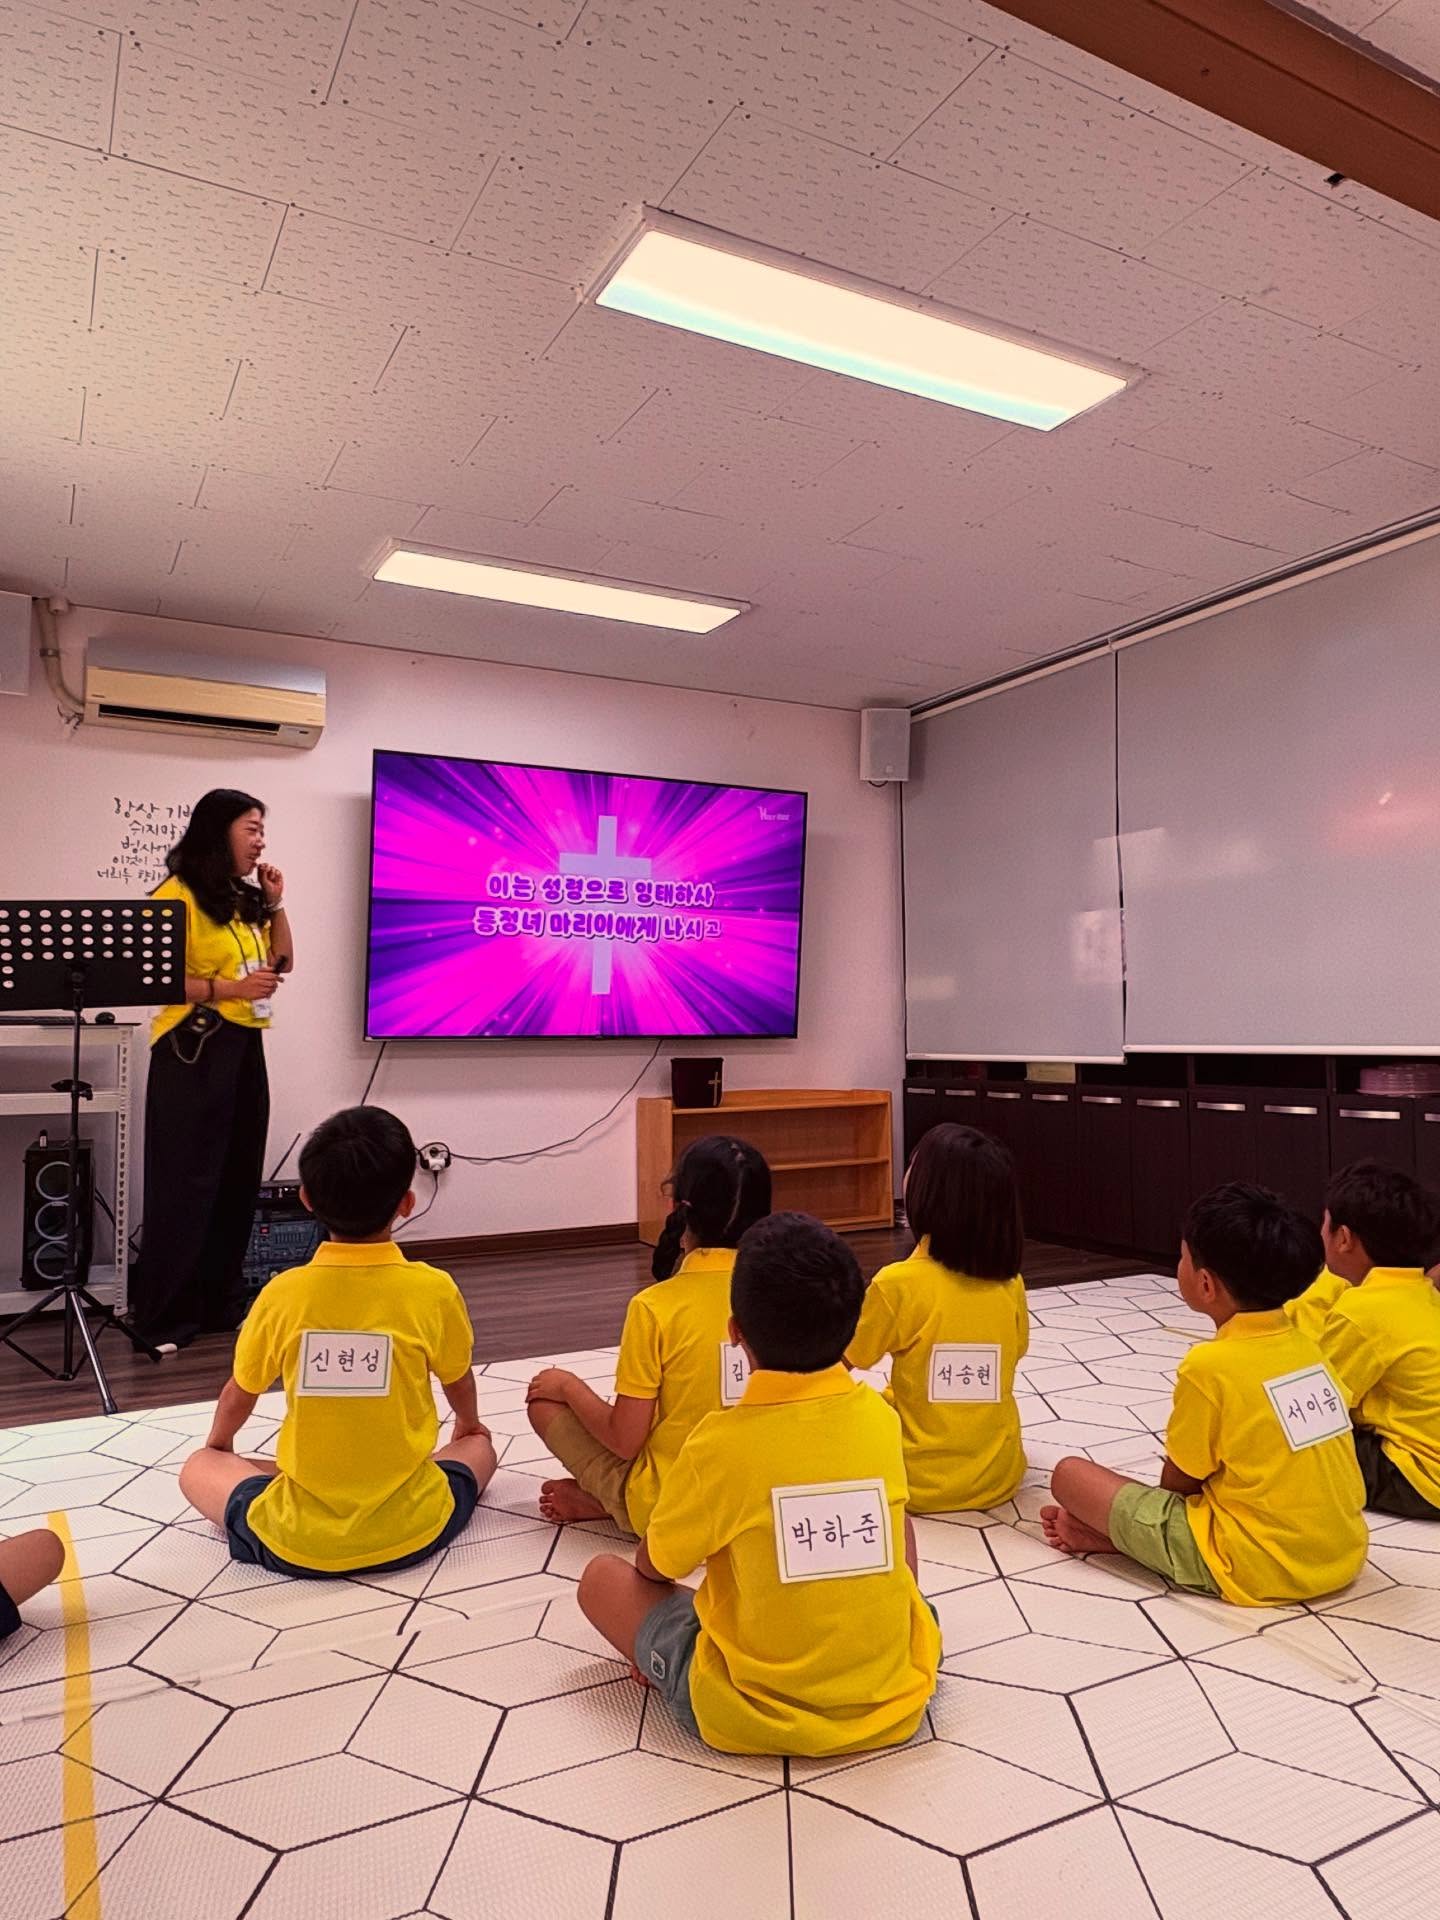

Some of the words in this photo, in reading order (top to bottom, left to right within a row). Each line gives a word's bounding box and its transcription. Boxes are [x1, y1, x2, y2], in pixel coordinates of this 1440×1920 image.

[487, 873, 534, 900] 이는
[541, 875, 628, 903] 성령으로
[310, 1348, 380, 1373] 신현성
[937, 1364, 990, 1386] 석송현
[1288, 1388, 1338, 1424] 서이음
[791, 1513, 879, 1552] 박하준
